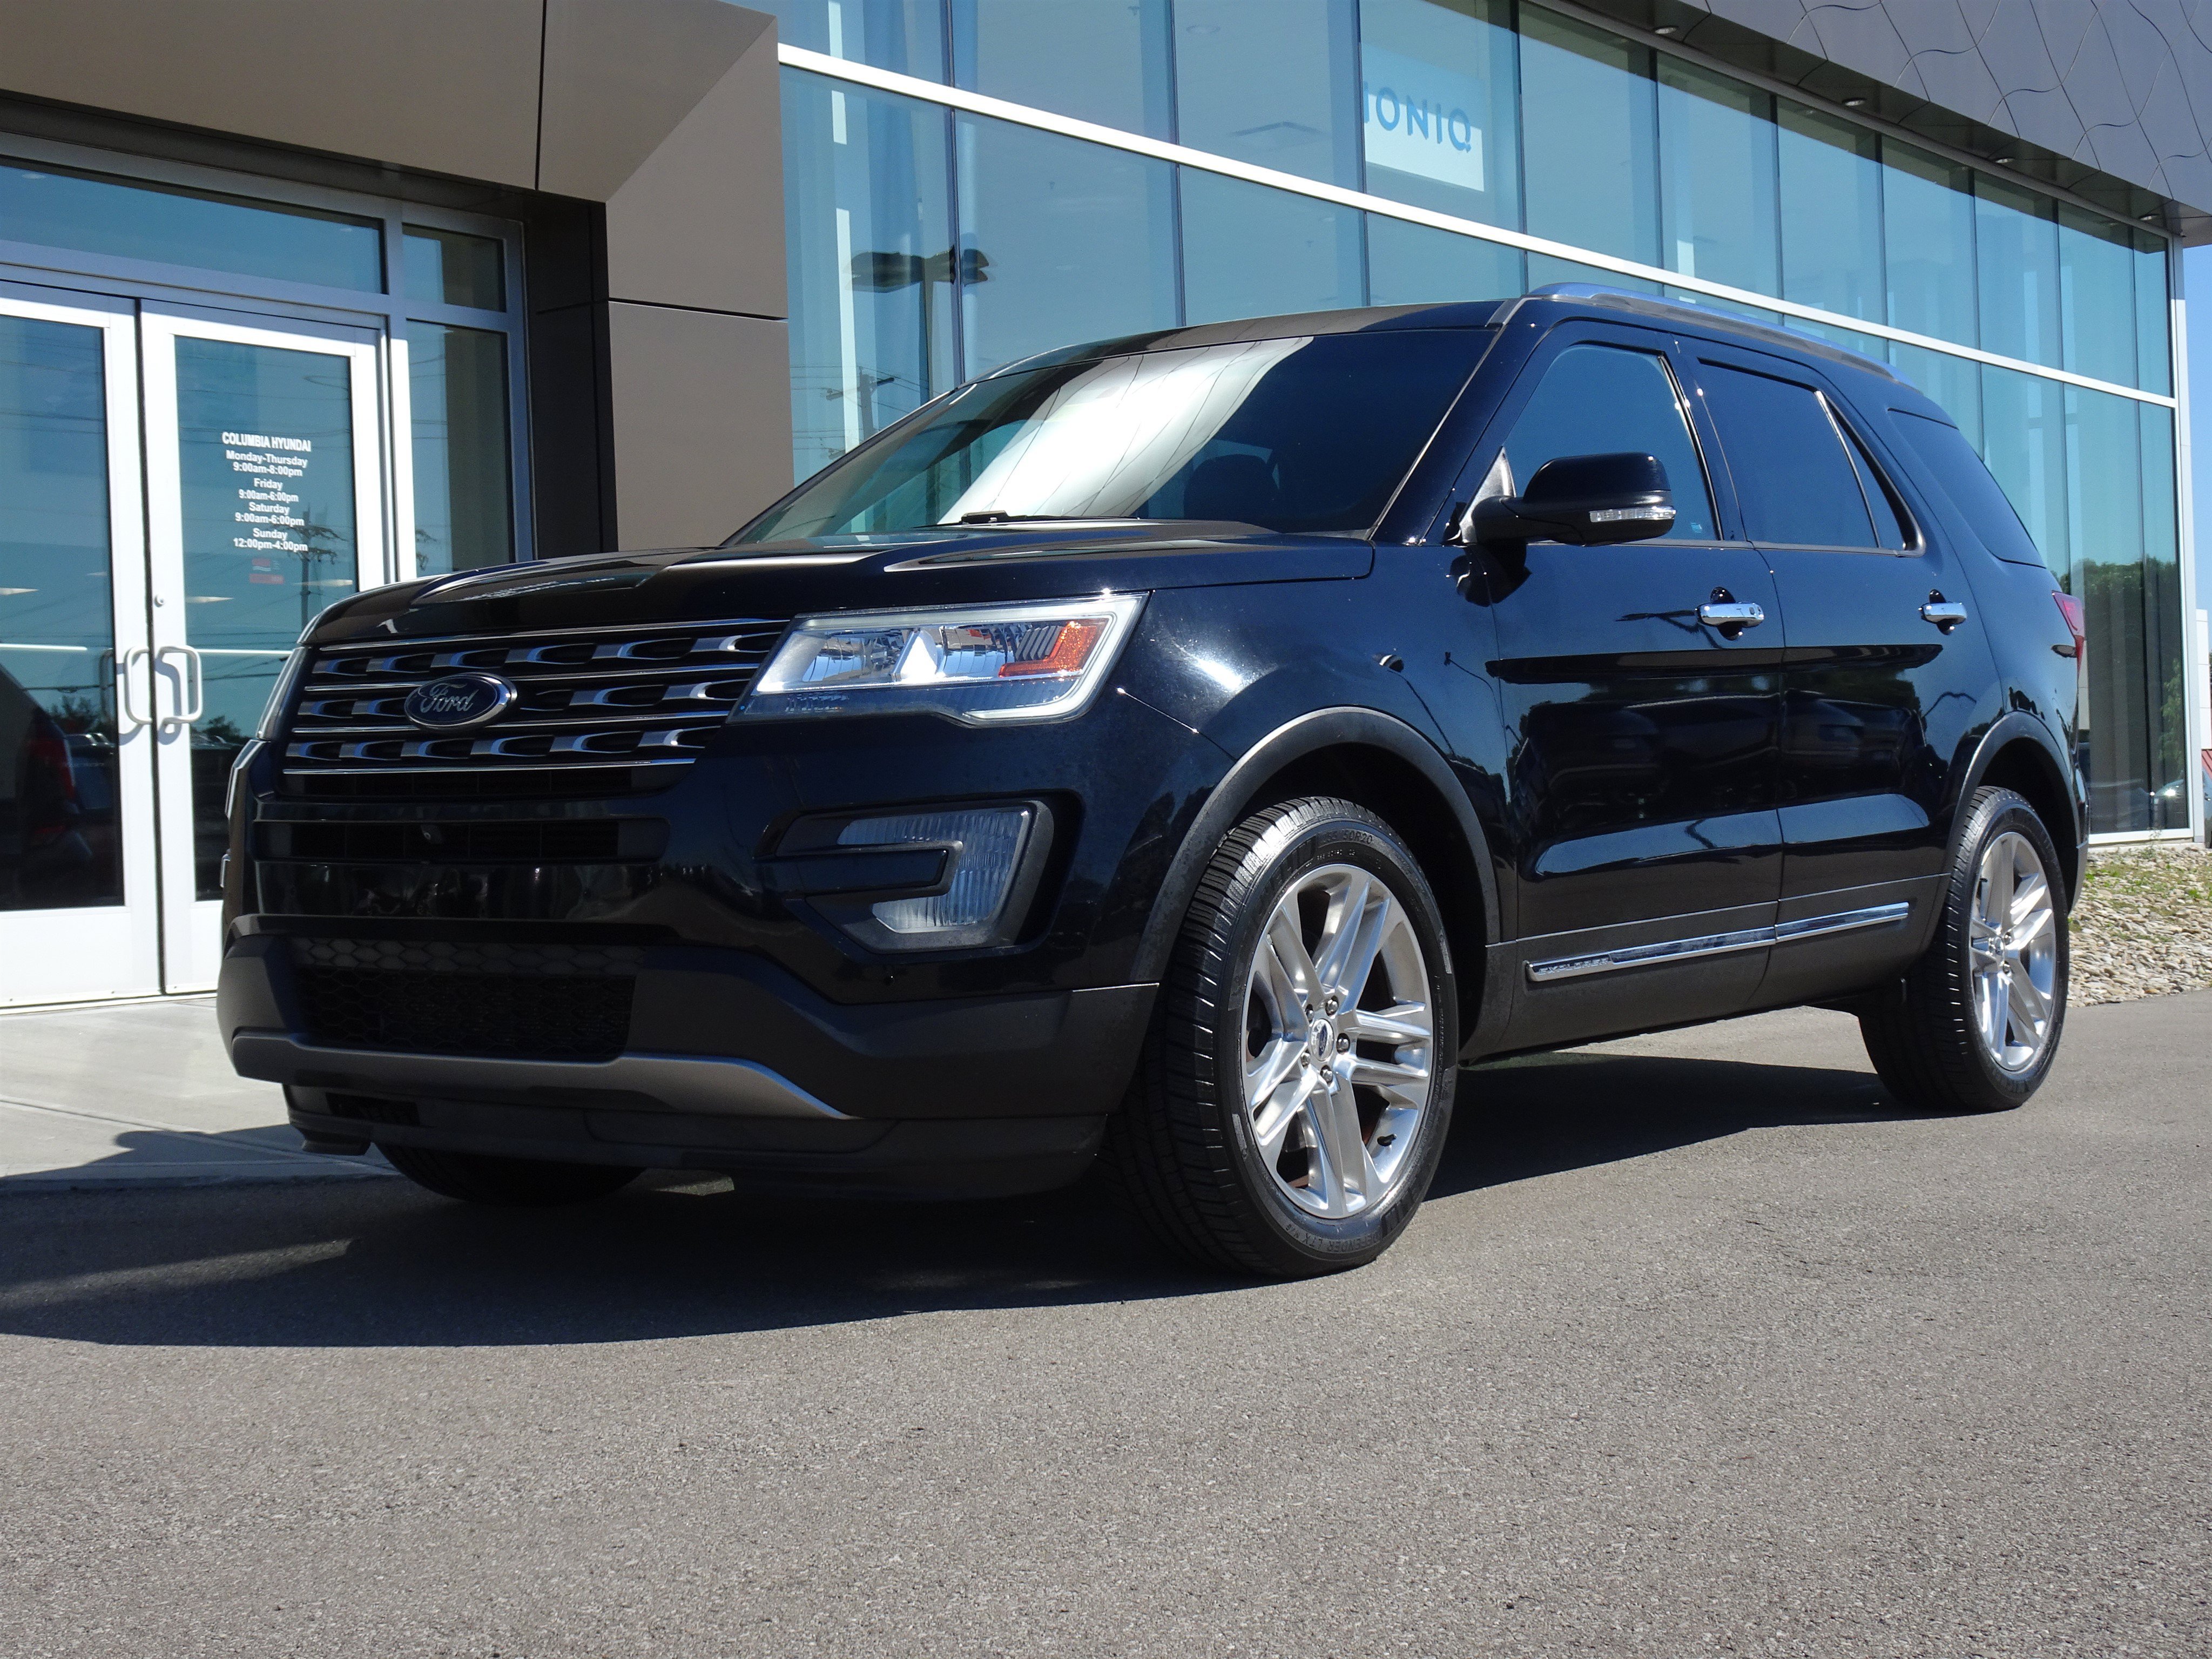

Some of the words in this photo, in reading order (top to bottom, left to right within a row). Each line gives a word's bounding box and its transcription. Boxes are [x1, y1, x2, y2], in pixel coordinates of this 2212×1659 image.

[1364, 81, 1472, 153] IONIQ
[222, 431, 271, 448] COLUMBIA
[271, 436, 312, 451] HYUNDAI
[226, 449, 308, 468] Monday-Thursday
[233, 462, 302, 477] 9:00am-8:00pm
[253, 478, 283, 491] Friday
[238, 489, 299, 503] 9:00am-6:00pm
[248, 502, 291, 515] Saturday
[234, 512, 305, 527] 9:00am-6:00pm
[253, 528, 288, 541] Sunday
[233, 538, 308, 552] 12:00pm-4:00pm
[420, 683, 480, 713] Ford
[1539, 957, 1609, 976] EXPLORER
